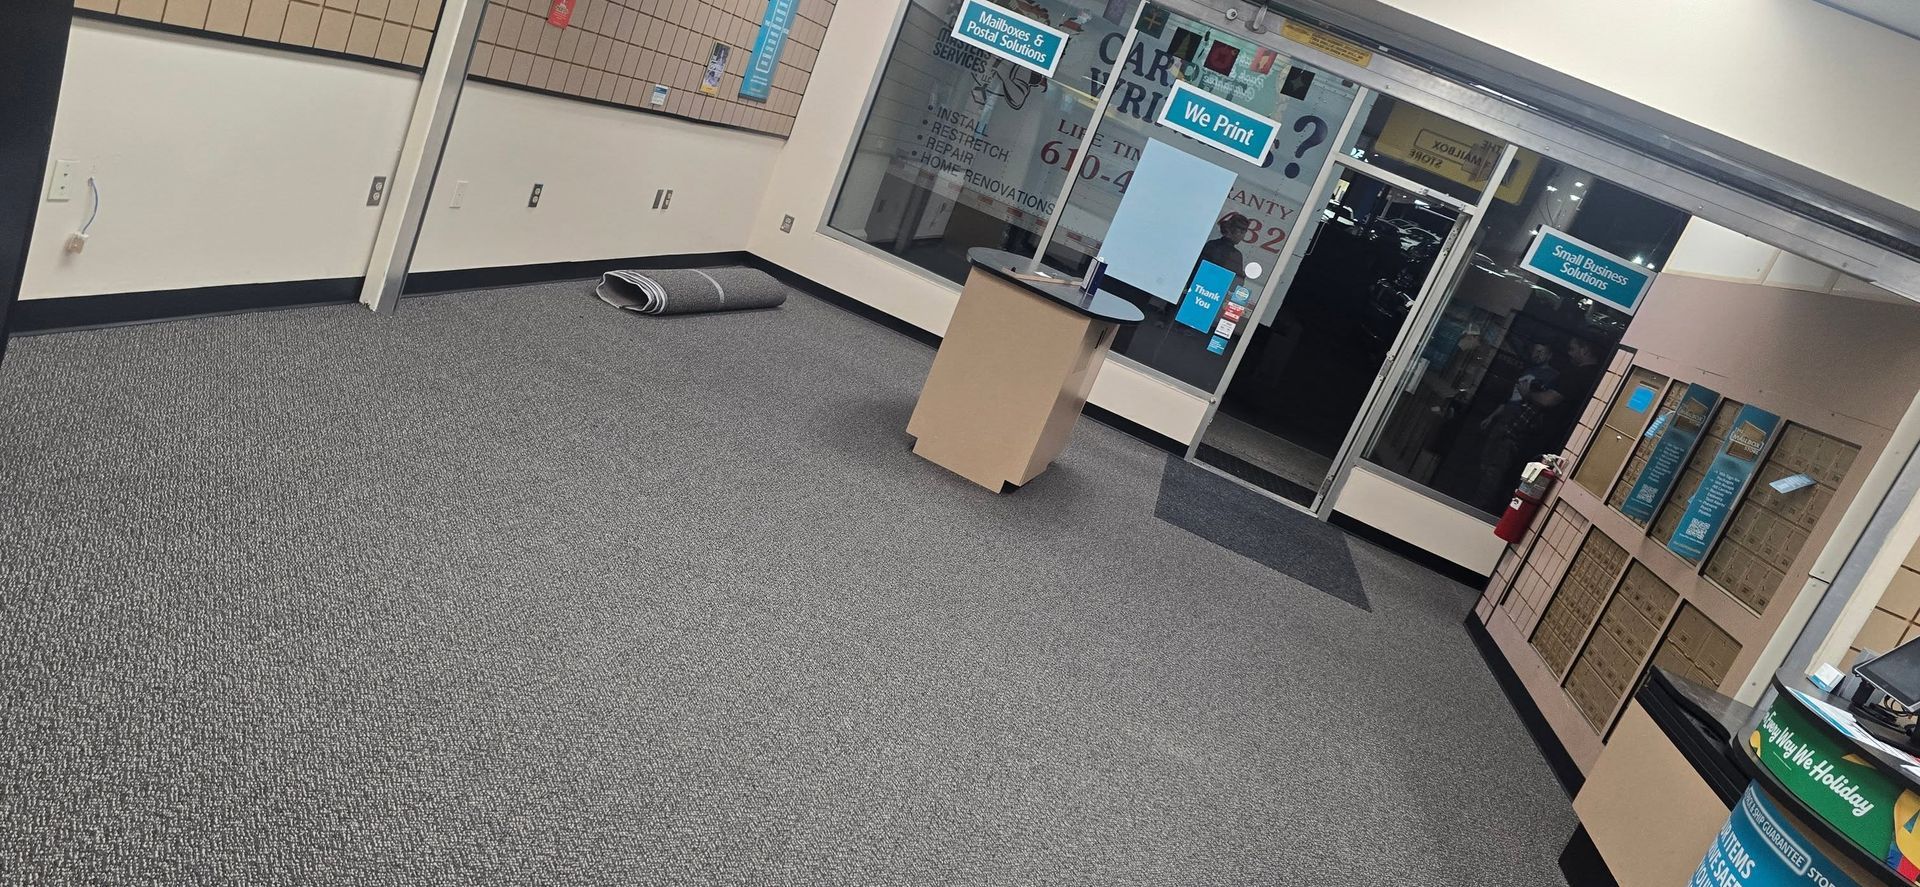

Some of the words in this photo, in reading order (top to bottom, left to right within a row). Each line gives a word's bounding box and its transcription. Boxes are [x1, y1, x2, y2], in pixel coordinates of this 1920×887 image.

[967, 21, 999, 43] Postal
[1000, 35, 1048, 63] Solutions
[979, 11, 1031, 42] Mailboxes
[1034, 34, 1045, 47] &
[933, 42, 987, 73] SERVICES
[937, 106, 989, 137] INSTALL
[1184, 101, 1211, 127] We
[1213, 117, 1254, 146] Print
[926, 137, 974, 166] REPAIR
[931, 122, 1010, 163] RESTRETCH
[921, 151, 961, 178] HOME
[964, 169, 1055, 216] RENOVATIONS
[1552, 245, 1583, 269] Small
[1584, 259, 1629, 286] Business
[1560, 262, 1608, 291] Solutions
[1195, 284, 1221, 302] Thank
[1195, 296, 1211, 310] You
[1763, 710, 1782, 743] Every
[1776, 727, 1798, 759] Way
[1792, 743, 1816, 770] We
[1808, 760, 1875, 817] Holiday
[1723, 831, 1756, 879] ITEMS
[1752, 808, 1764, 825] SHIP
[1762, 821, 1805, 868] GUARANTEE
